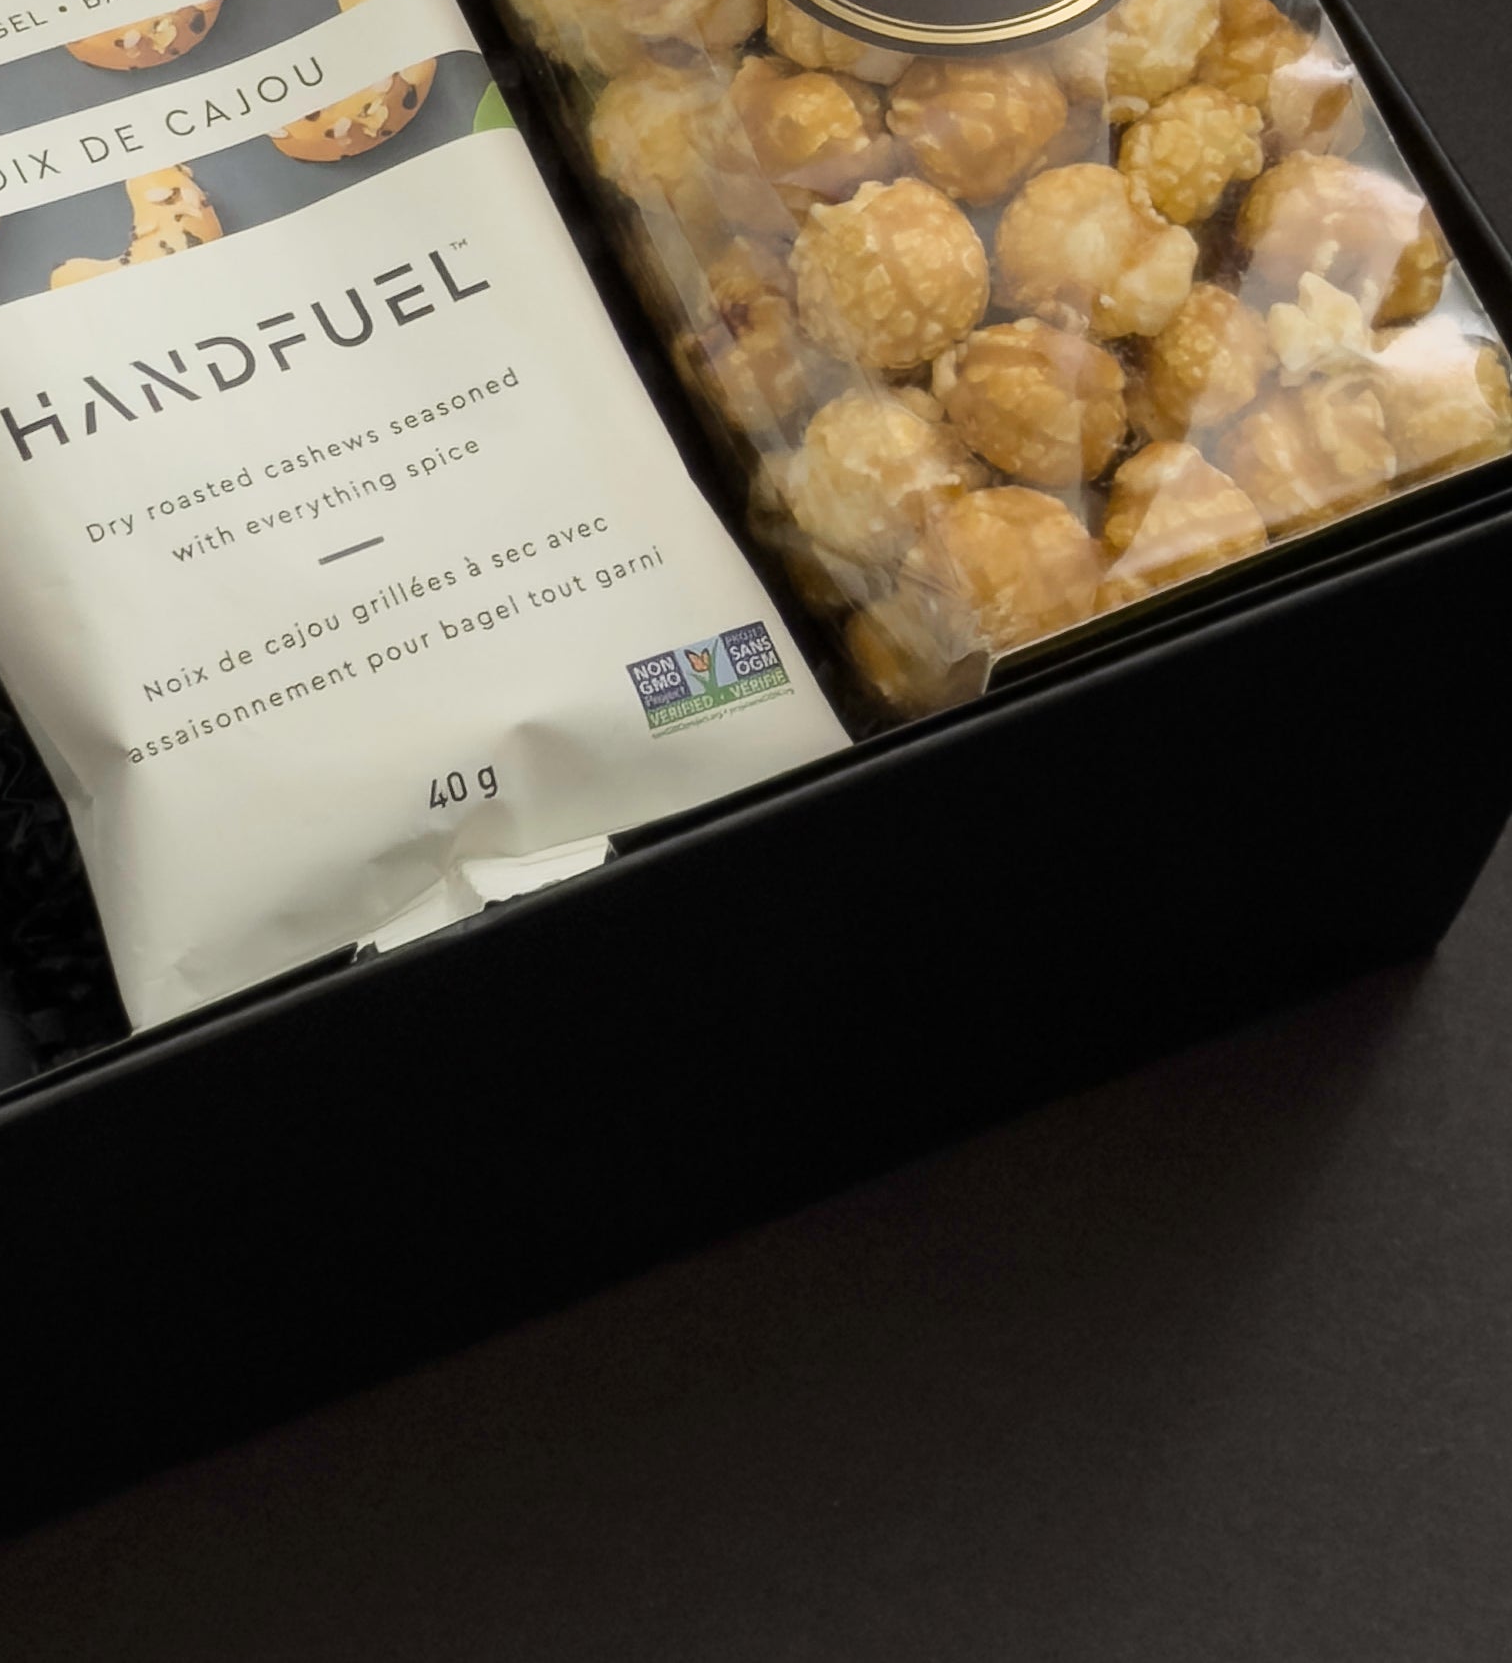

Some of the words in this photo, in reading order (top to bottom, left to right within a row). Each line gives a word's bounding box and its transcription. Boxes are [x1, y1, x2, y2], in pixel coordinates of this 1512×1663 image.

[79, 124, 144, 164] DE
[165, 56, 324, 137] CAJOU
[0, 250, 491, 462] HANDFUEL
[85, 513, 135, 544] Dry
[146, 467, 255, 521] roasted
[264, 428, 380, 480] cashews
[389, 367, 520, 436] seasoned
[171, 525, 236, 563] with
[246, 471, 398, 537] everything
[406, 437, 481, 482] spice
[143, 664, 210, 703] Noix
[218, 646, 255, 675] de
[264, 614, 341, 658] cajou
[352, 568, 459, 625] grillées
[464, 556, 483, 579] à
[491, 539, 538, 570] sec
[546, 515, 610, 550] avec
[128, 659, 359, 765] assaisonnement
[367, 631, 432, 674] pour
[439, 594, 520, 641] bagel
[527, 573, 588, 609] tout
[596, 544, 665, 588] garni
[633, 656, 675, 682] NON
[639, 671, 681, 695] GMO
[729, 635, 773, 661] SANS
[735, 652, 780, 676] OGM
[650, 695, 714, 727] VERIFIED
[428, 770, 468, 810] 40
[478, 764, 499, 801] g
